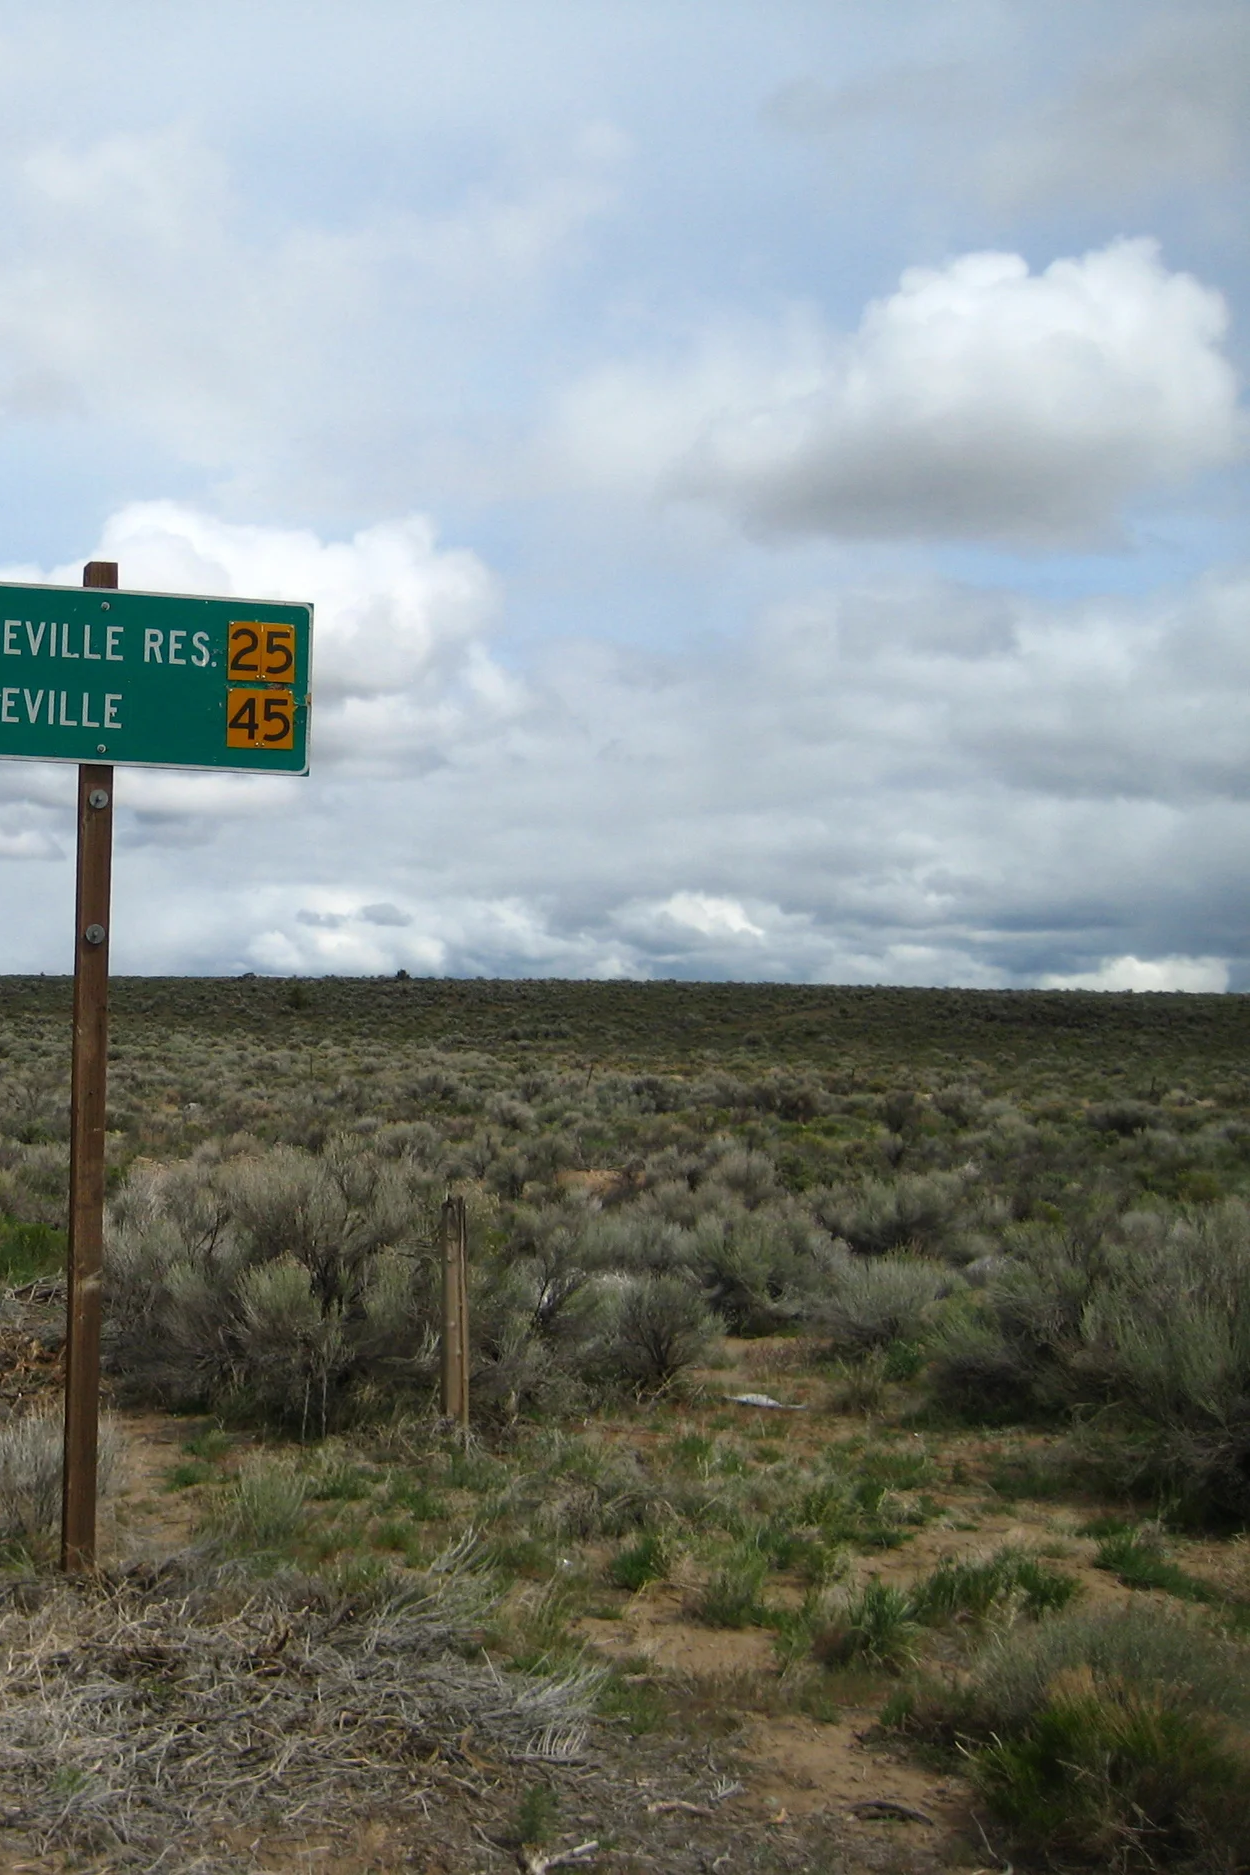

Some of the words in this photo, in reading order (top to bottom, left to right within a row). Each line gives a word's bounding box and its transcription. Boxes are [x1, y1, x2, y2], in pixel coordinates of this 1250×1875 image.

[143, 627, 218, 668] RES.
[229, 627, 294, 675] 25
[227, 697, 291, 743] 45
